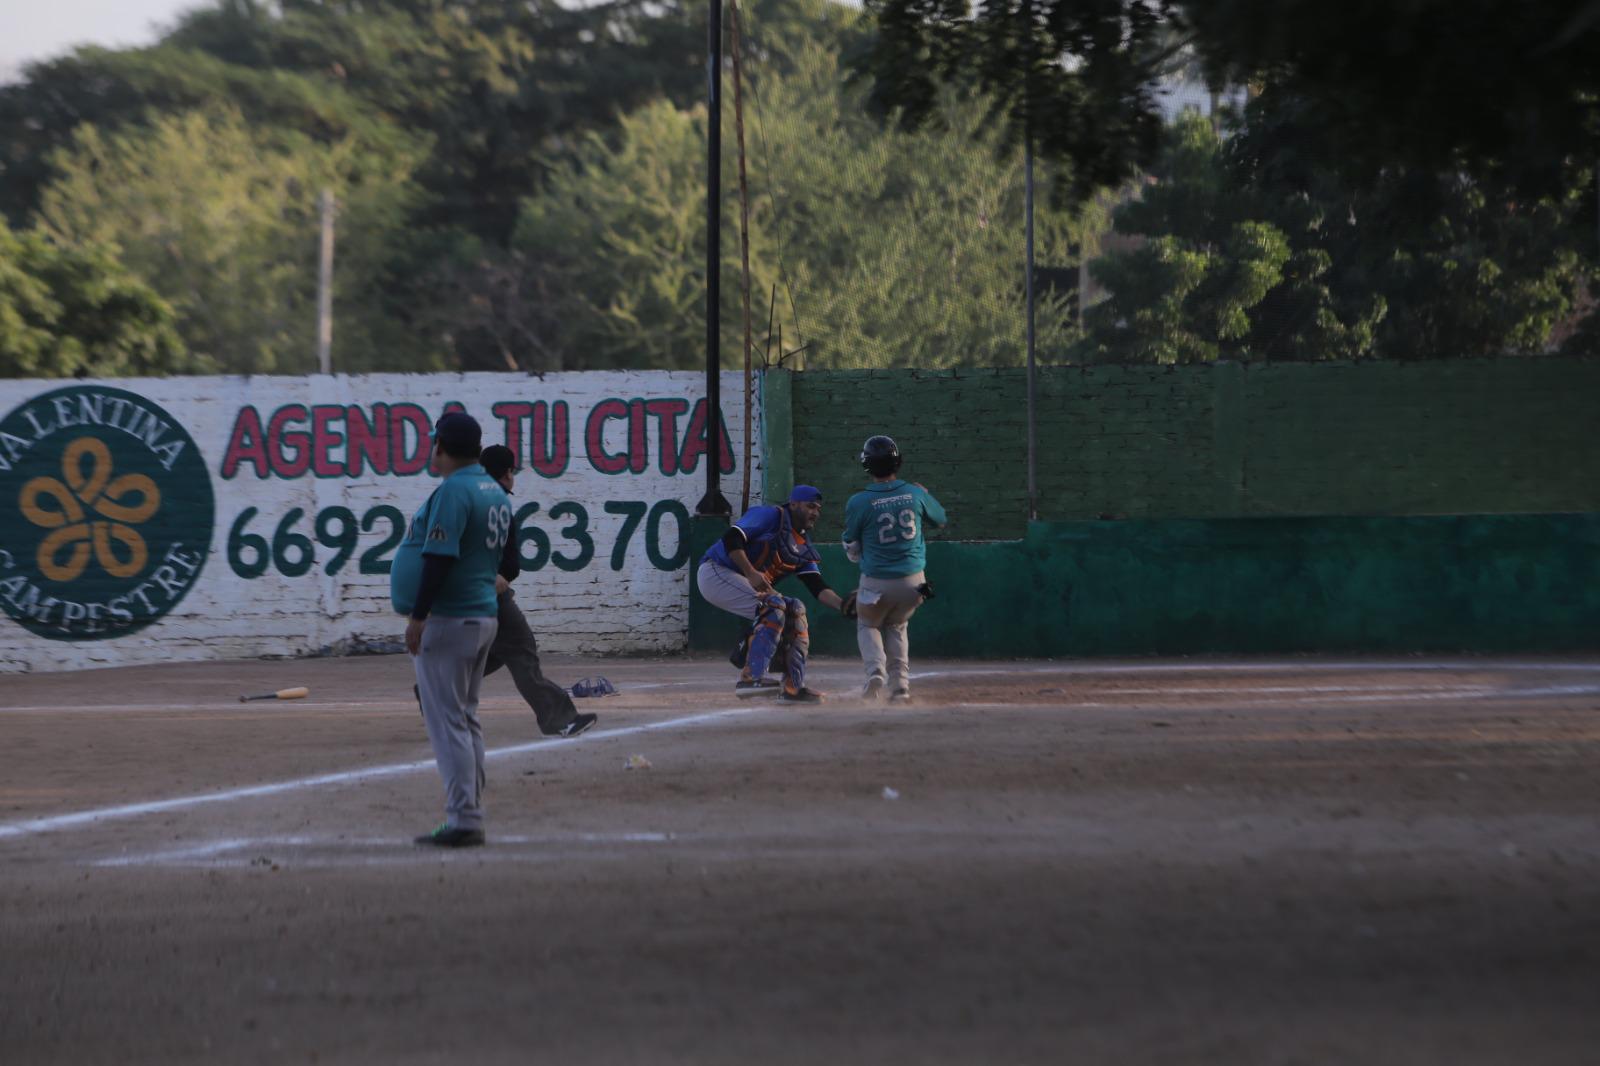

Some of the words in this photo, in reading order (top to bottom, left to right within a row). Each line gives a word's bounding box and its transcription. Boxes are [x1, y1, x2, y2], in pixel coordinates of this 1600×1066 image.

[221, 402, 467, 479] AGEND
[492, 400, 569, 478] TU
[585, 397, 736, 476] CITA
[486, 504, 510, 549] 99
[878, 509, 916, 544] 29
